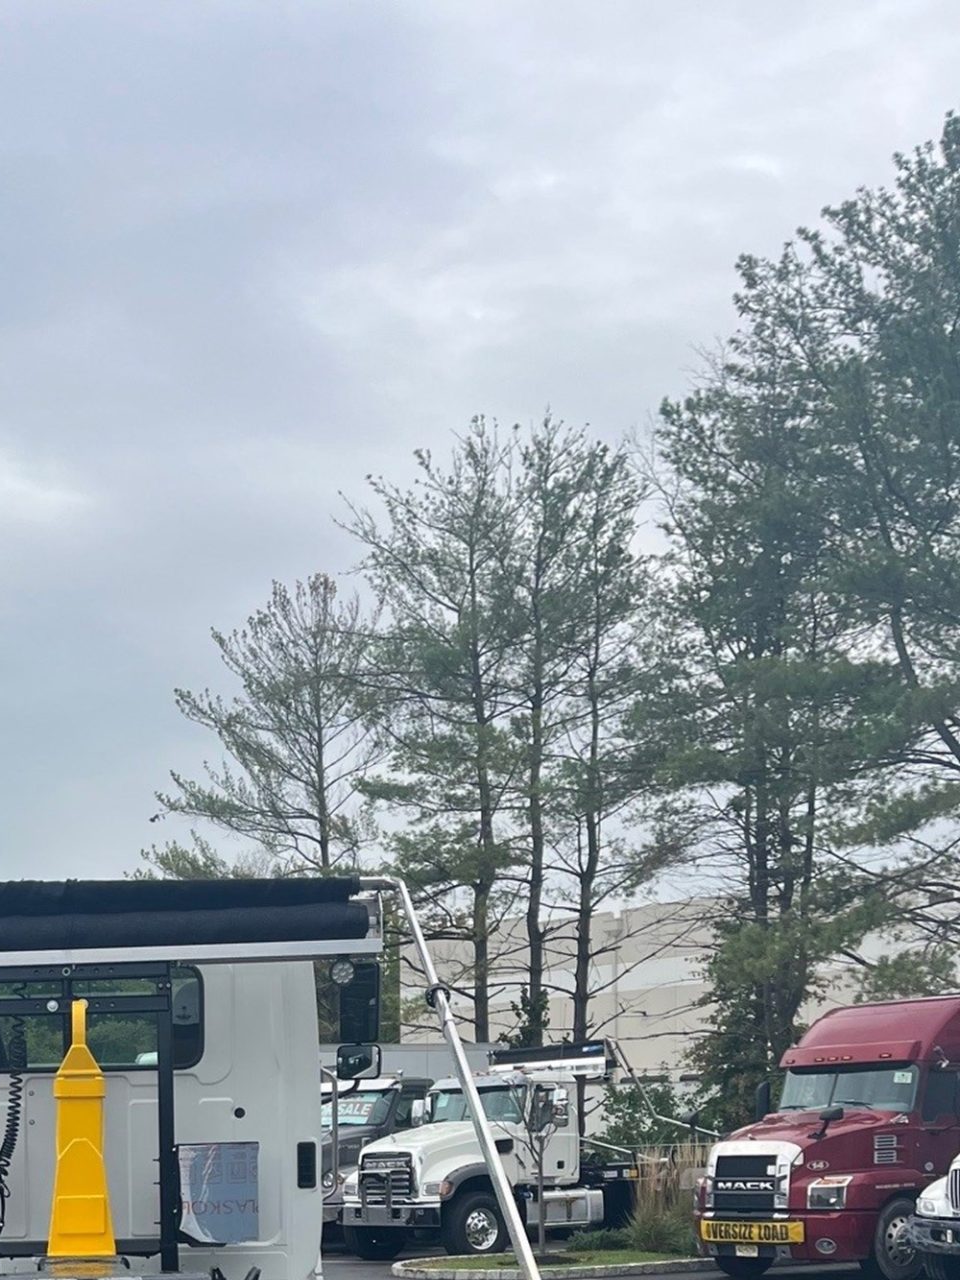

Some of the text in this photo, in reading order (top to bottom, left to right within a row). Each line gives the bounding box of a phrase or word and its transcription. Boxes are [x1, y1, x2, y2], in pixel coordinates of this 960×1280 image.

[337, 1103, 372, 1116] SALE
[365, 1161, 407, 1169] MACK
[717, 1181, 774, 1190] MACK
[705, 1222, 790, 1241] OVERSIZE LOAD
